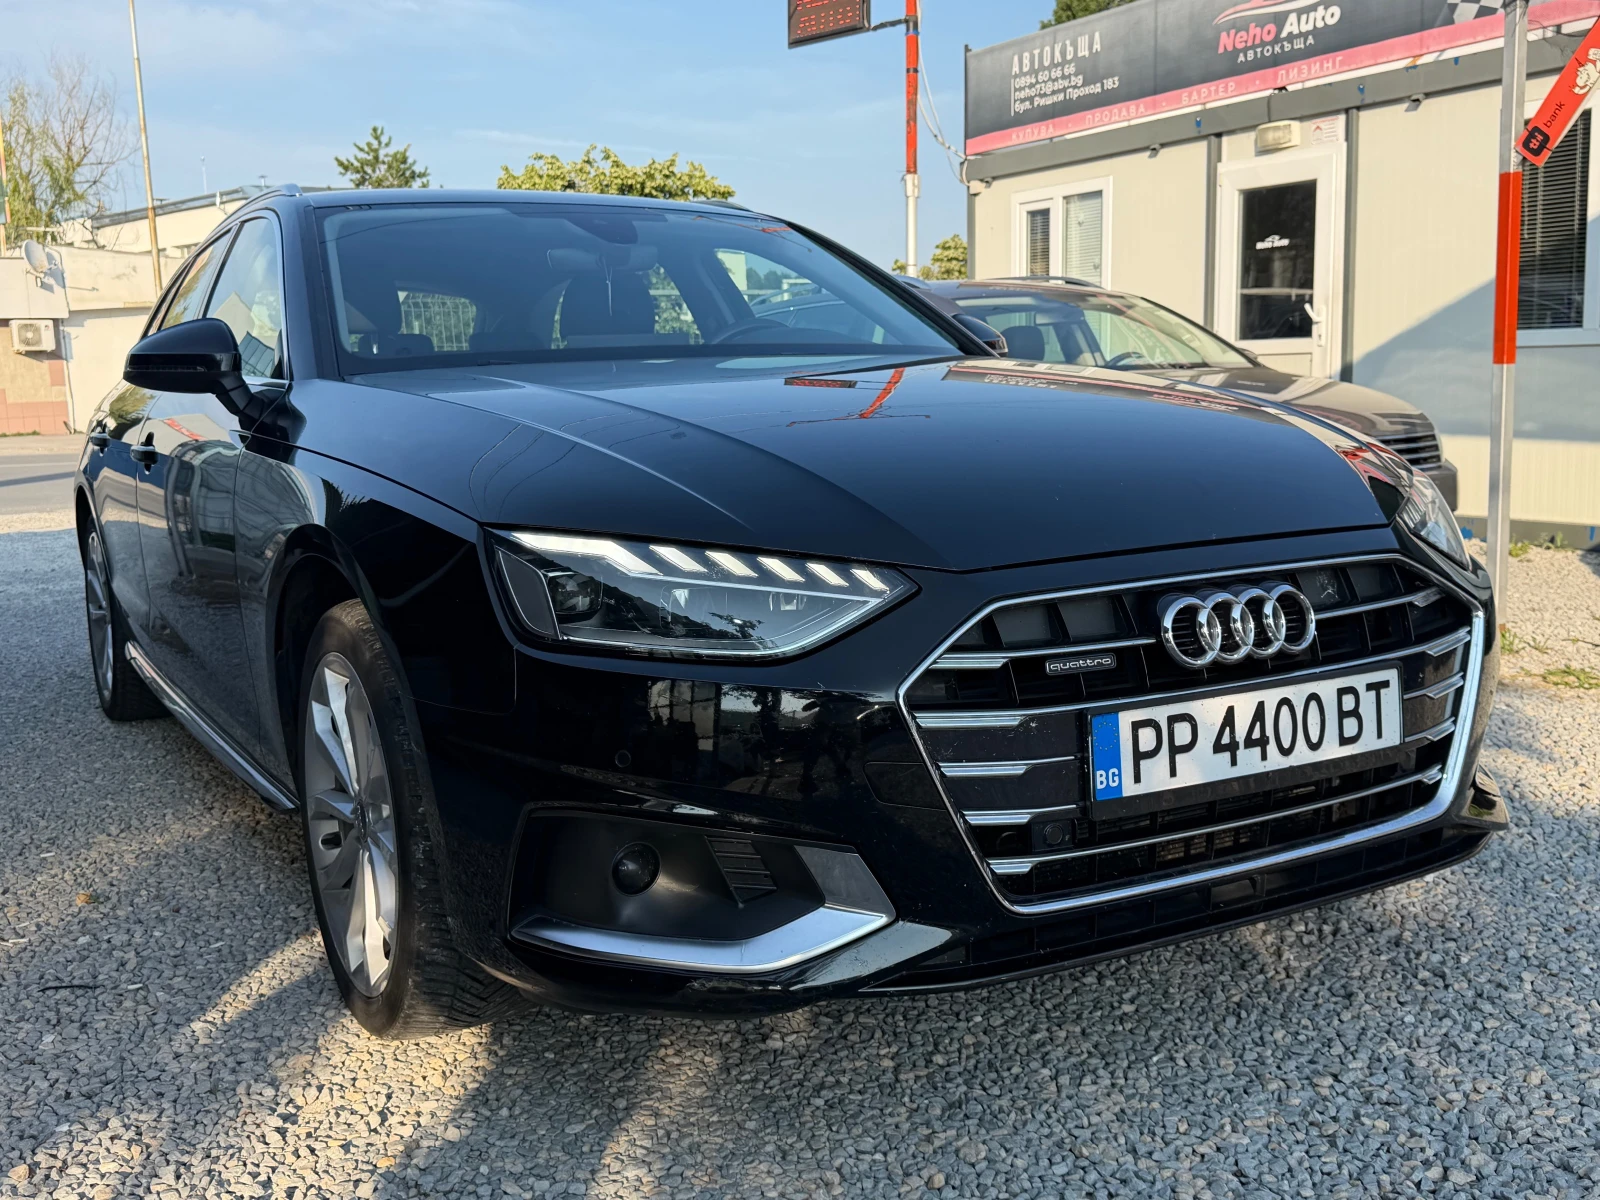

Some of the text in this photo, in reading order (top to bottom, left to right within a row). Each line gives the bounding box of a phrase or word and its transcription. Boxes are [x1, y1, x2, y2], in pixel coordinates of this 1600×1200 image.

[1218, 5, 1341, 54] Neho Auto
[1011, 31, 1101, 75] АВТОКЪЩА
[1237, 35, 1315, 63] АВТОКЪЩА
[1014, 62, 1076, 88] 0894 60 66 66
[1014, 74, 1084, 100] neho73@abv.bg
[1011, 56, 1343, 142] КУПУВА ПРОДАВА БАРТЕР ЛИЗИНГ
[1034, 92, 1064, 108] Ришки
[1066, 83, 1101, 100] Проход
[1103, 76, 1119, 90] 183
[1543, 101, 1565, 128] bank
[1050, 658, 1111, 671] quattro
[1131, 679, 1391, 784] PP 4400 BT
[1096, 768, 1120, 790] BG
